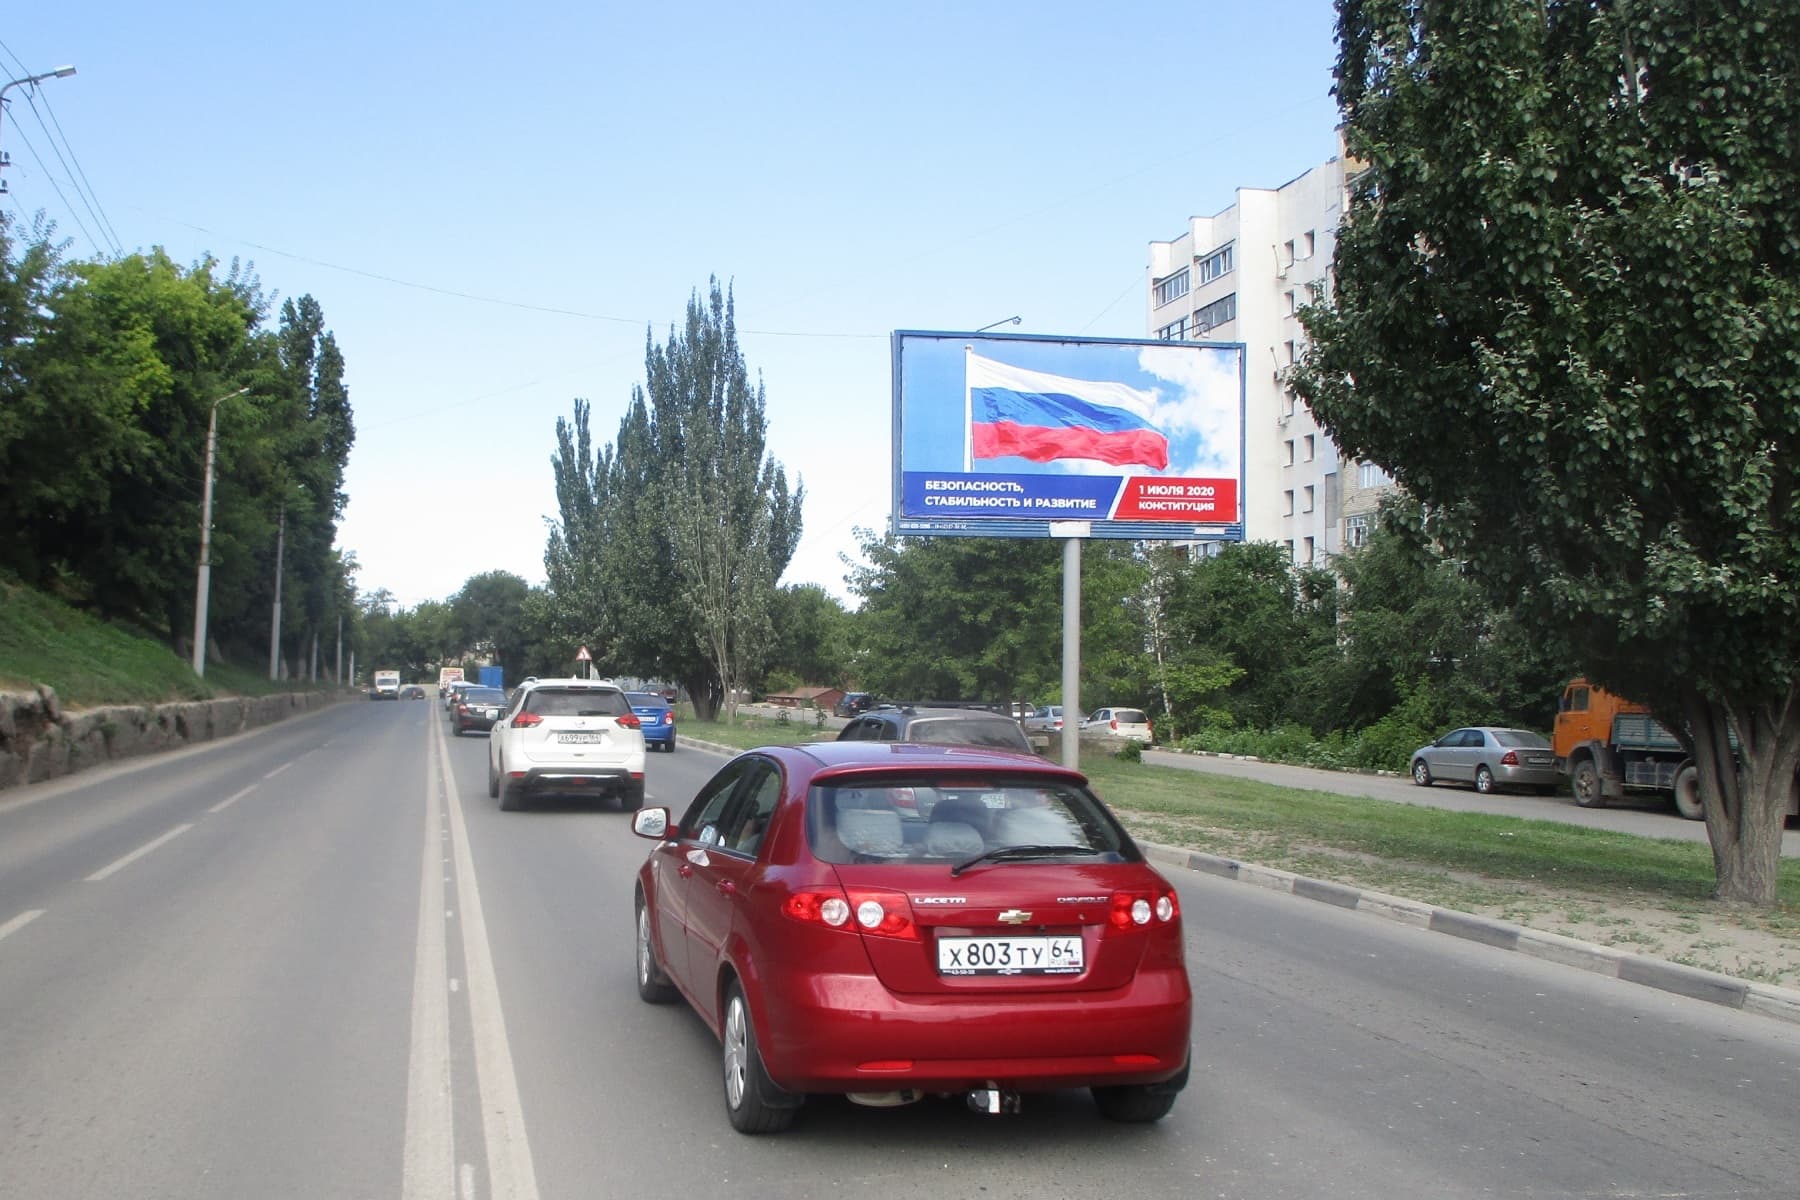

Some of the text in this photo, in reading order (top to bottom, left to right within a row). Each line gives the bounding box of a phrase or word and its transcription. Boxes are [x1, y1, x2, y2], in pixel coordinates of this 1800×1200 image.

[925, 480, 1024, 493] БЕЗОПАСНОСТЬ,
[1139, 485, 1215, 497] 1 ИЮЛЯ 2020
[925, 496, 1097, 509] СТАБИЛЬНОСТЬ И РАЗВИТИЕ
[1138, 501, 1215, 512] КОНСТИТУЦИЯ
[1051, 939, 1074, 958] 64
